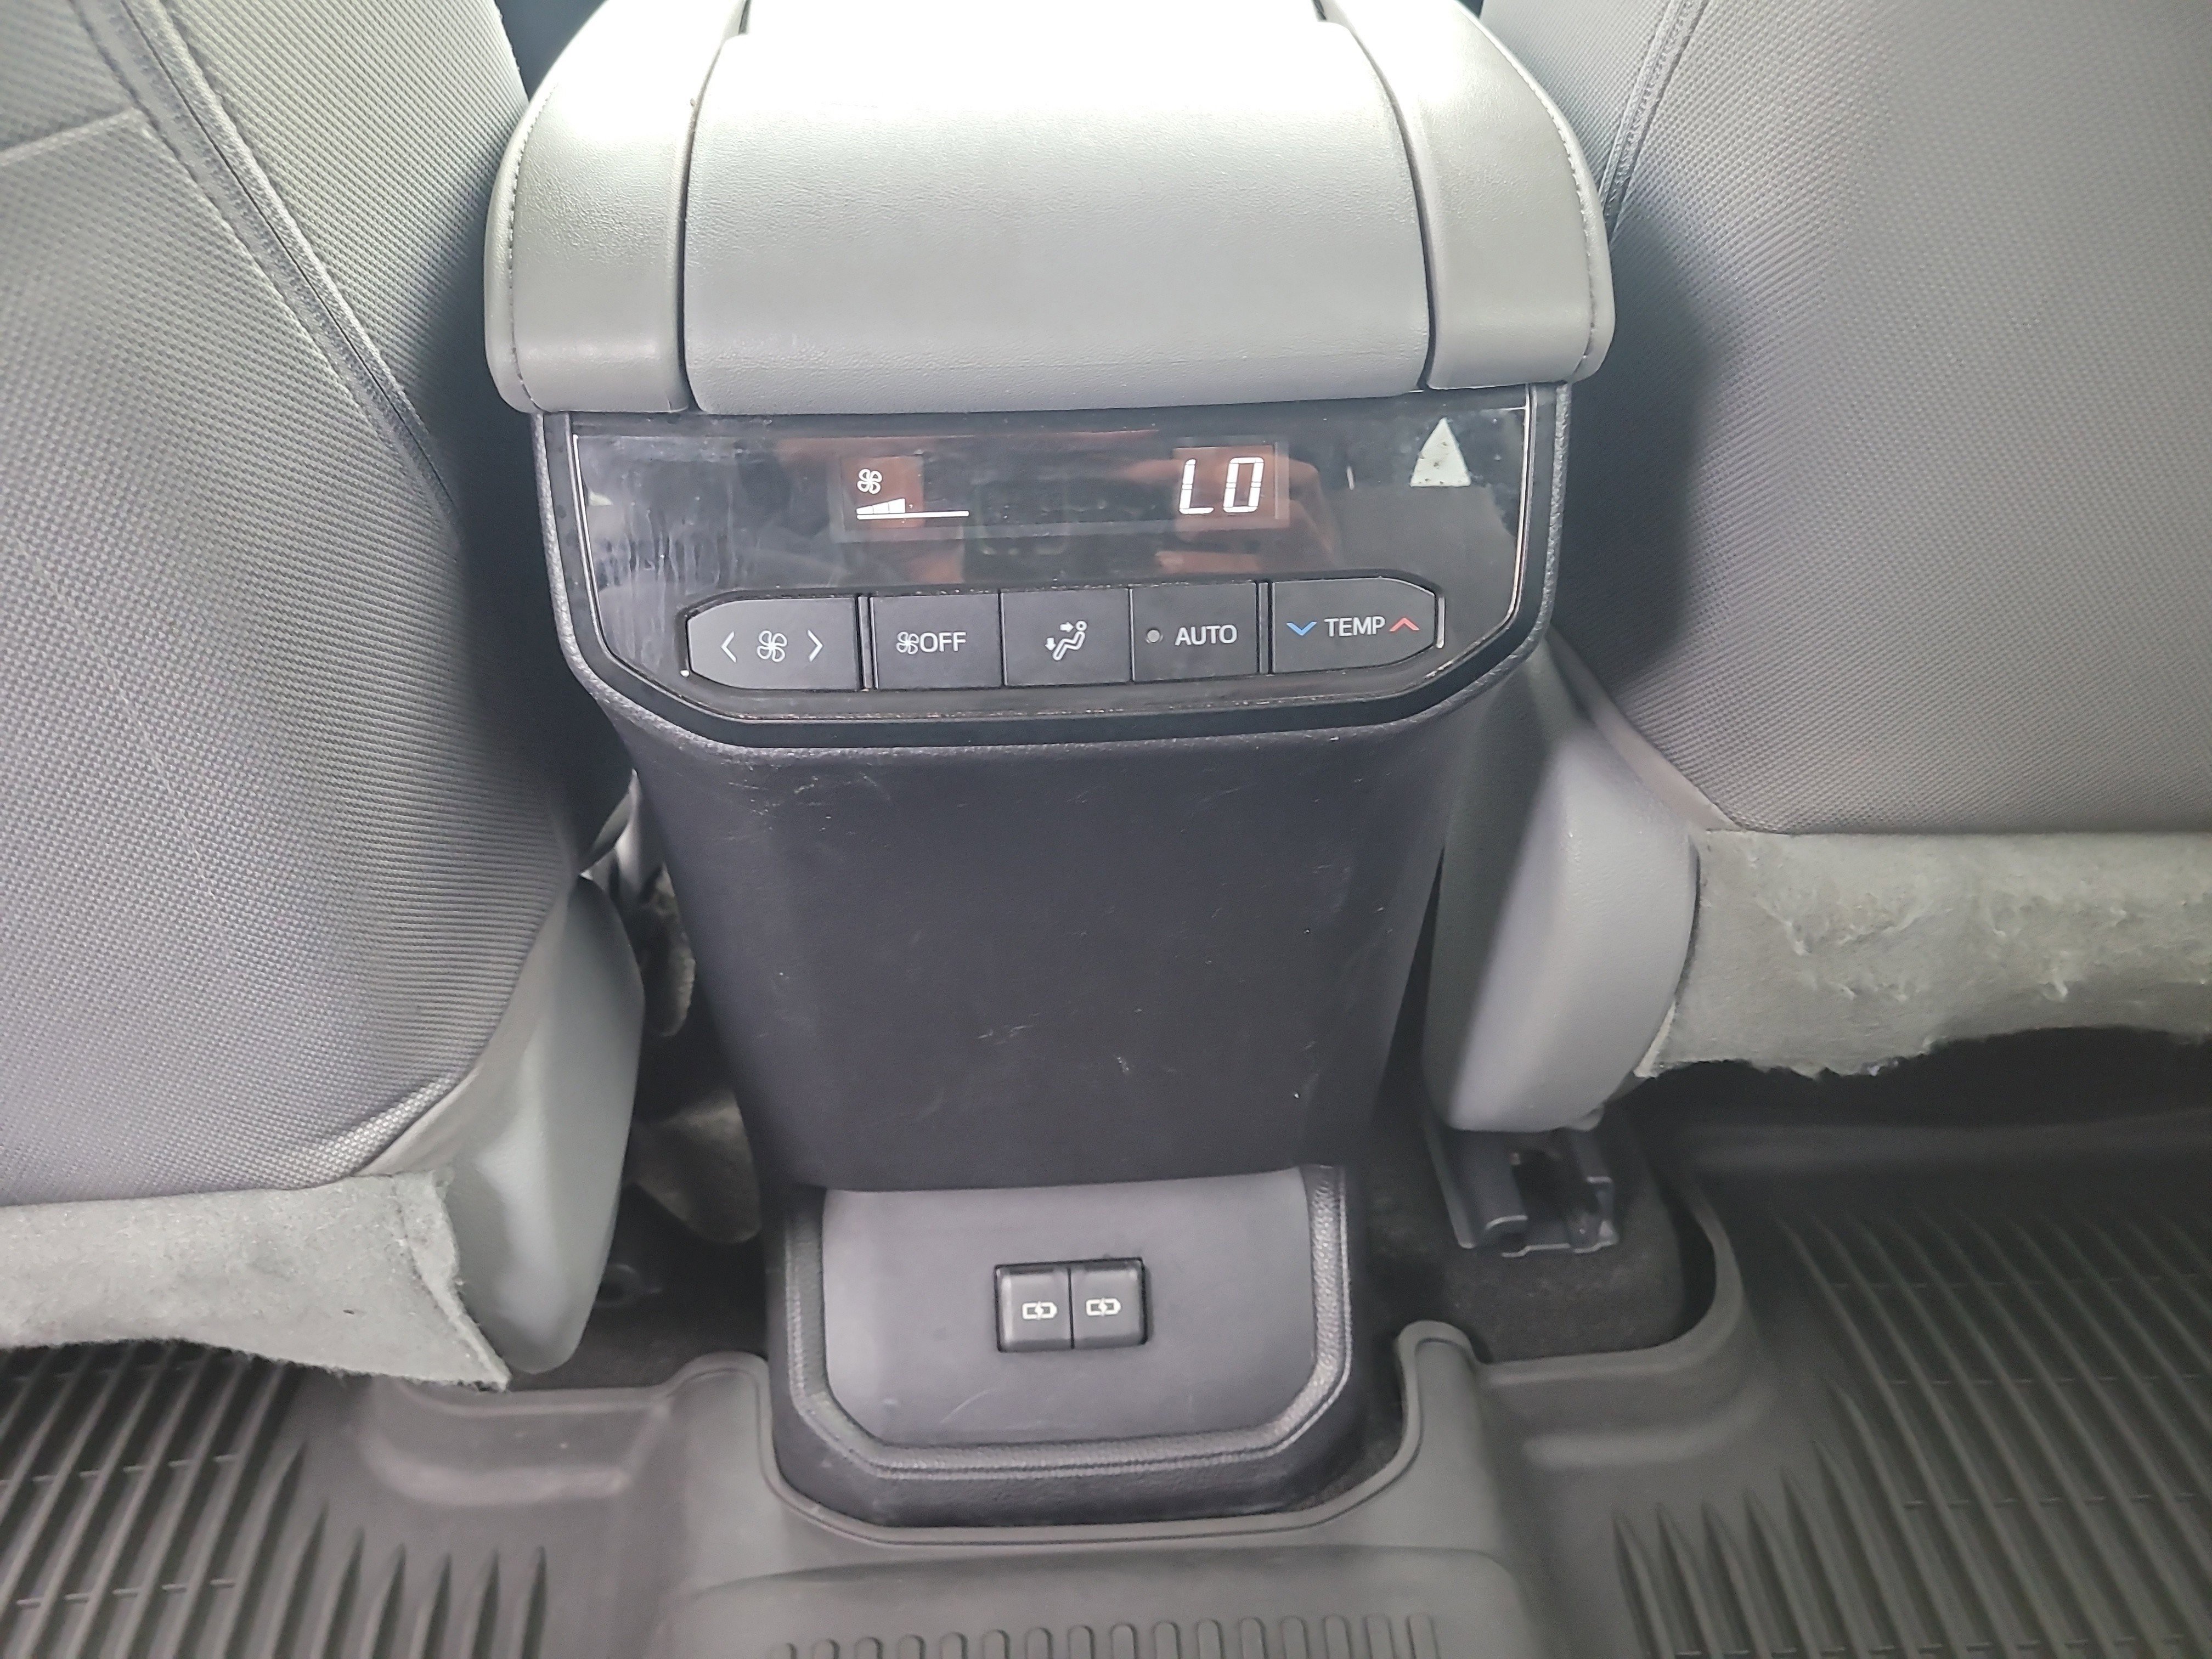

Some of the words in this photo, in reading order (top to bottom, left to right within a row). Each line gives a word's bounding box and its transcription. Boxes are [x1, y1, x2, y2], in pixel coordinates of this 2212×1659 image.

[1179, 456, 1265, 515] LO
[1175, 623, 1237, 646] AUTO
[1324, 616, 1385, 637] TEMP
[921, 630, 967, 653] OFF
